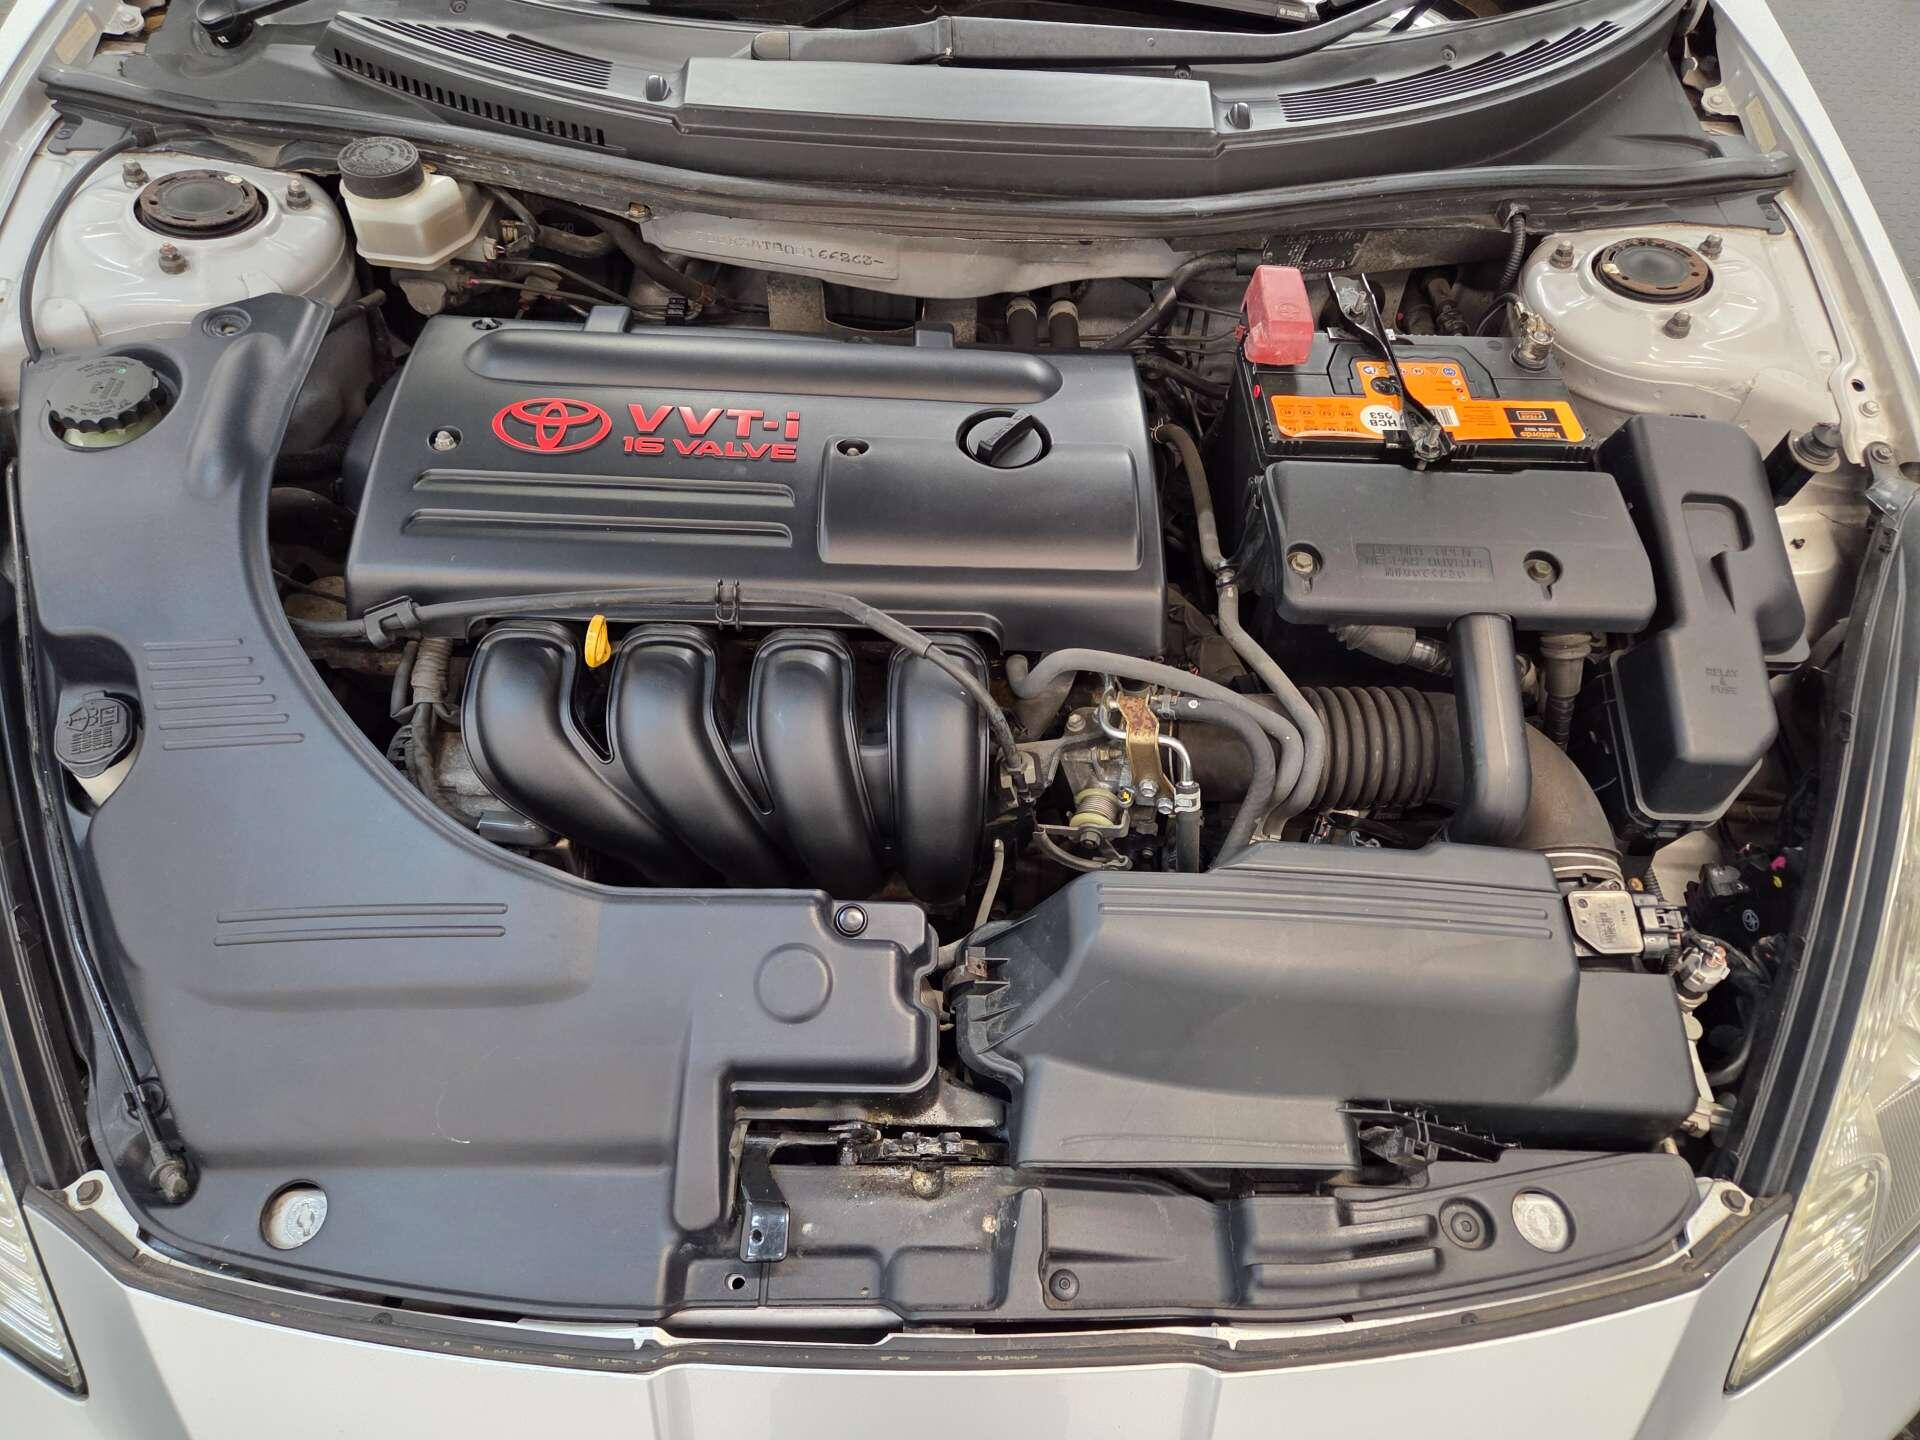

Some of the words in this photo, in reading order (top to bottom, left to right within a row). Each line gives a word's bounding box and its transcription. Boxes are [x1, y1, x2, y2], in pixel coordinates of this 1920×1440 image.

[628, 403, 800, 440] VVT-i
[1369, 419, 1398, 427] HCB
[623, 436, 665, 454] 16
[672, 438, 797, 461] VALVE
